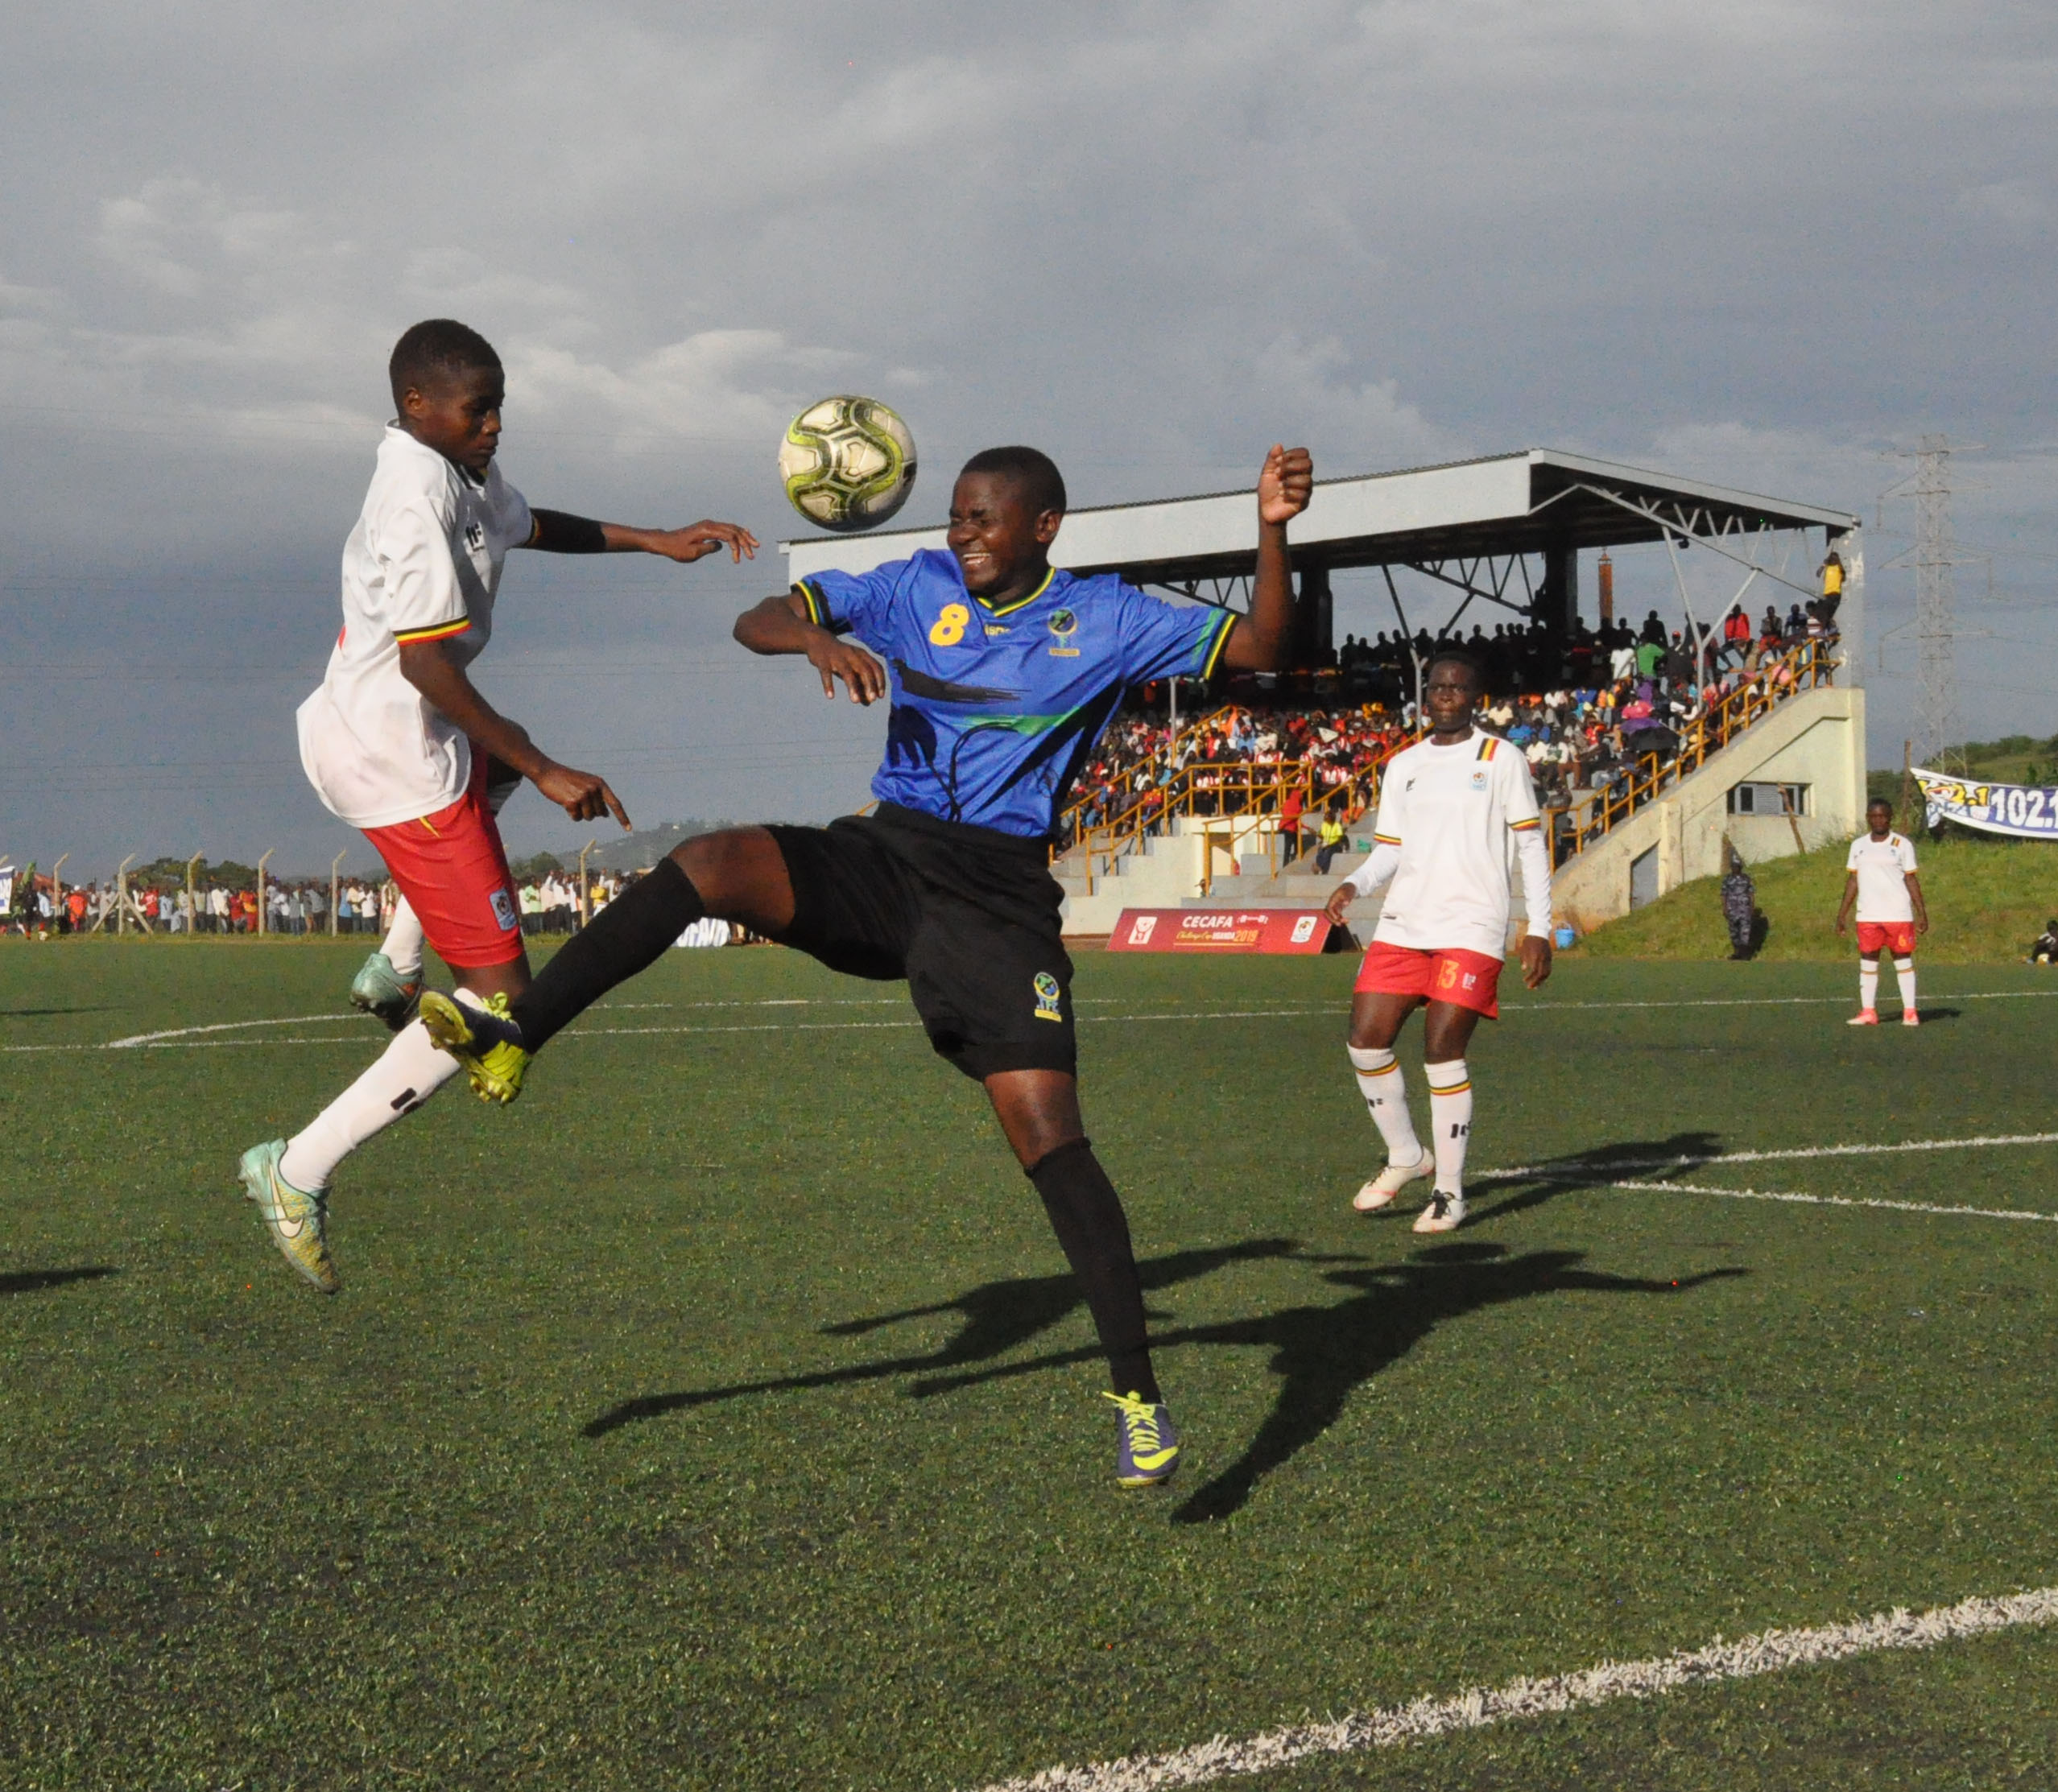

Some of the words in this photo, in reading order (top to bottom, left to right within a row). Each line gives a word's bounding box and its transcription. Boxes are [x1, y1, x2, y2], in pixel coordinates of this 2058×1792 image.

[929, 603, 969, 646] 8
[1182, 915, 1233, 928] CECAFA
[1233, 929, 1258, 942] 2019
